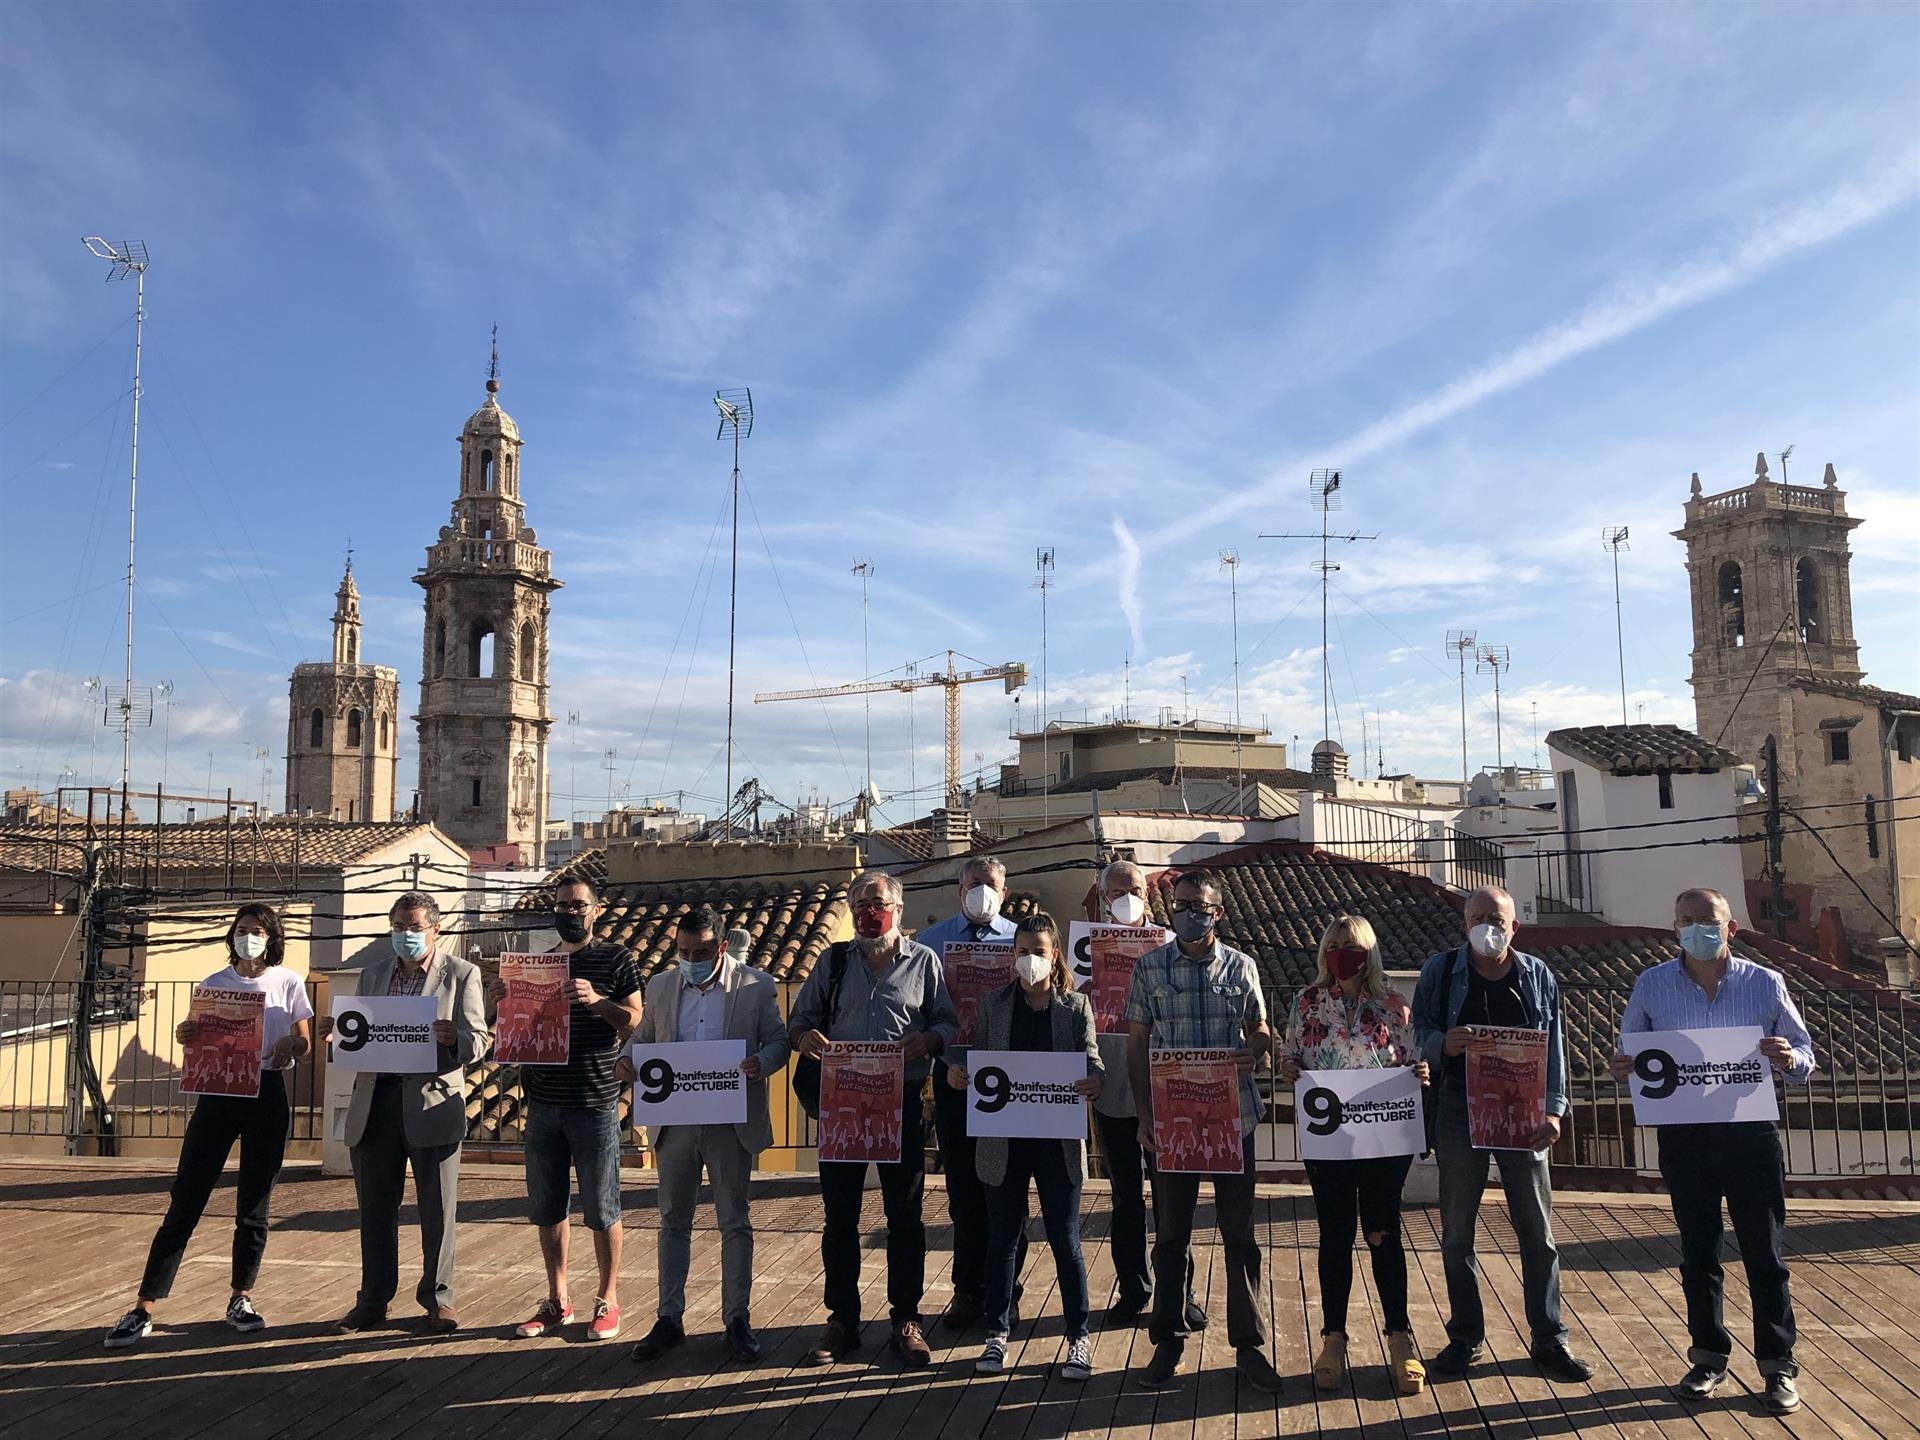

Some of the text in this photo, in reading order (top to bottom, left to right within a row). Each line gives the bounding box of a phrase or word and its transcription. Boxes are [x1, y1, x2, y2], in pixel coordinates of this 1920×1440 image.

[1091, 929, 1165, 938] 9 D'OCTUBRE
[945, 943, 953, 951] 9
[501, 955, 569, 965] 9 D'OCTUBRE
[194, 988, 266, 1002] 9 D'OCTUBRE
[336, 1010, 368, 1051] 9
[367, 1023, 430, 1033] Manifestació
[1479, 1028, 1548, 1042] D'OCTUBRE
[367, 1033, 430, 1043] D'OCTUBRE
[1151, 1051, 1160, 1061] 9
[1675, 1059, 1762, 1074] Manifestació
[639, 1058, 674, 1104] 9
[673, 1069, 740, 1081] Manifestació
[1634, 1049, 1678, 1099] 9
[1676, 1072, 1763, 1086] D'OCTUBRE
[672, 1080, 739, 1092] D'OCTUBRE
[973, 1066, 1010, 1113] 9
[1008, 1093, 1079, 1104] D'OCTUBRE
[1340, 1098, 1416, 1112] Manifestació
[1303, 1087, 1341, 1136] 9
[1340, 1109, 1416, 1124] D'OCTUBRE
